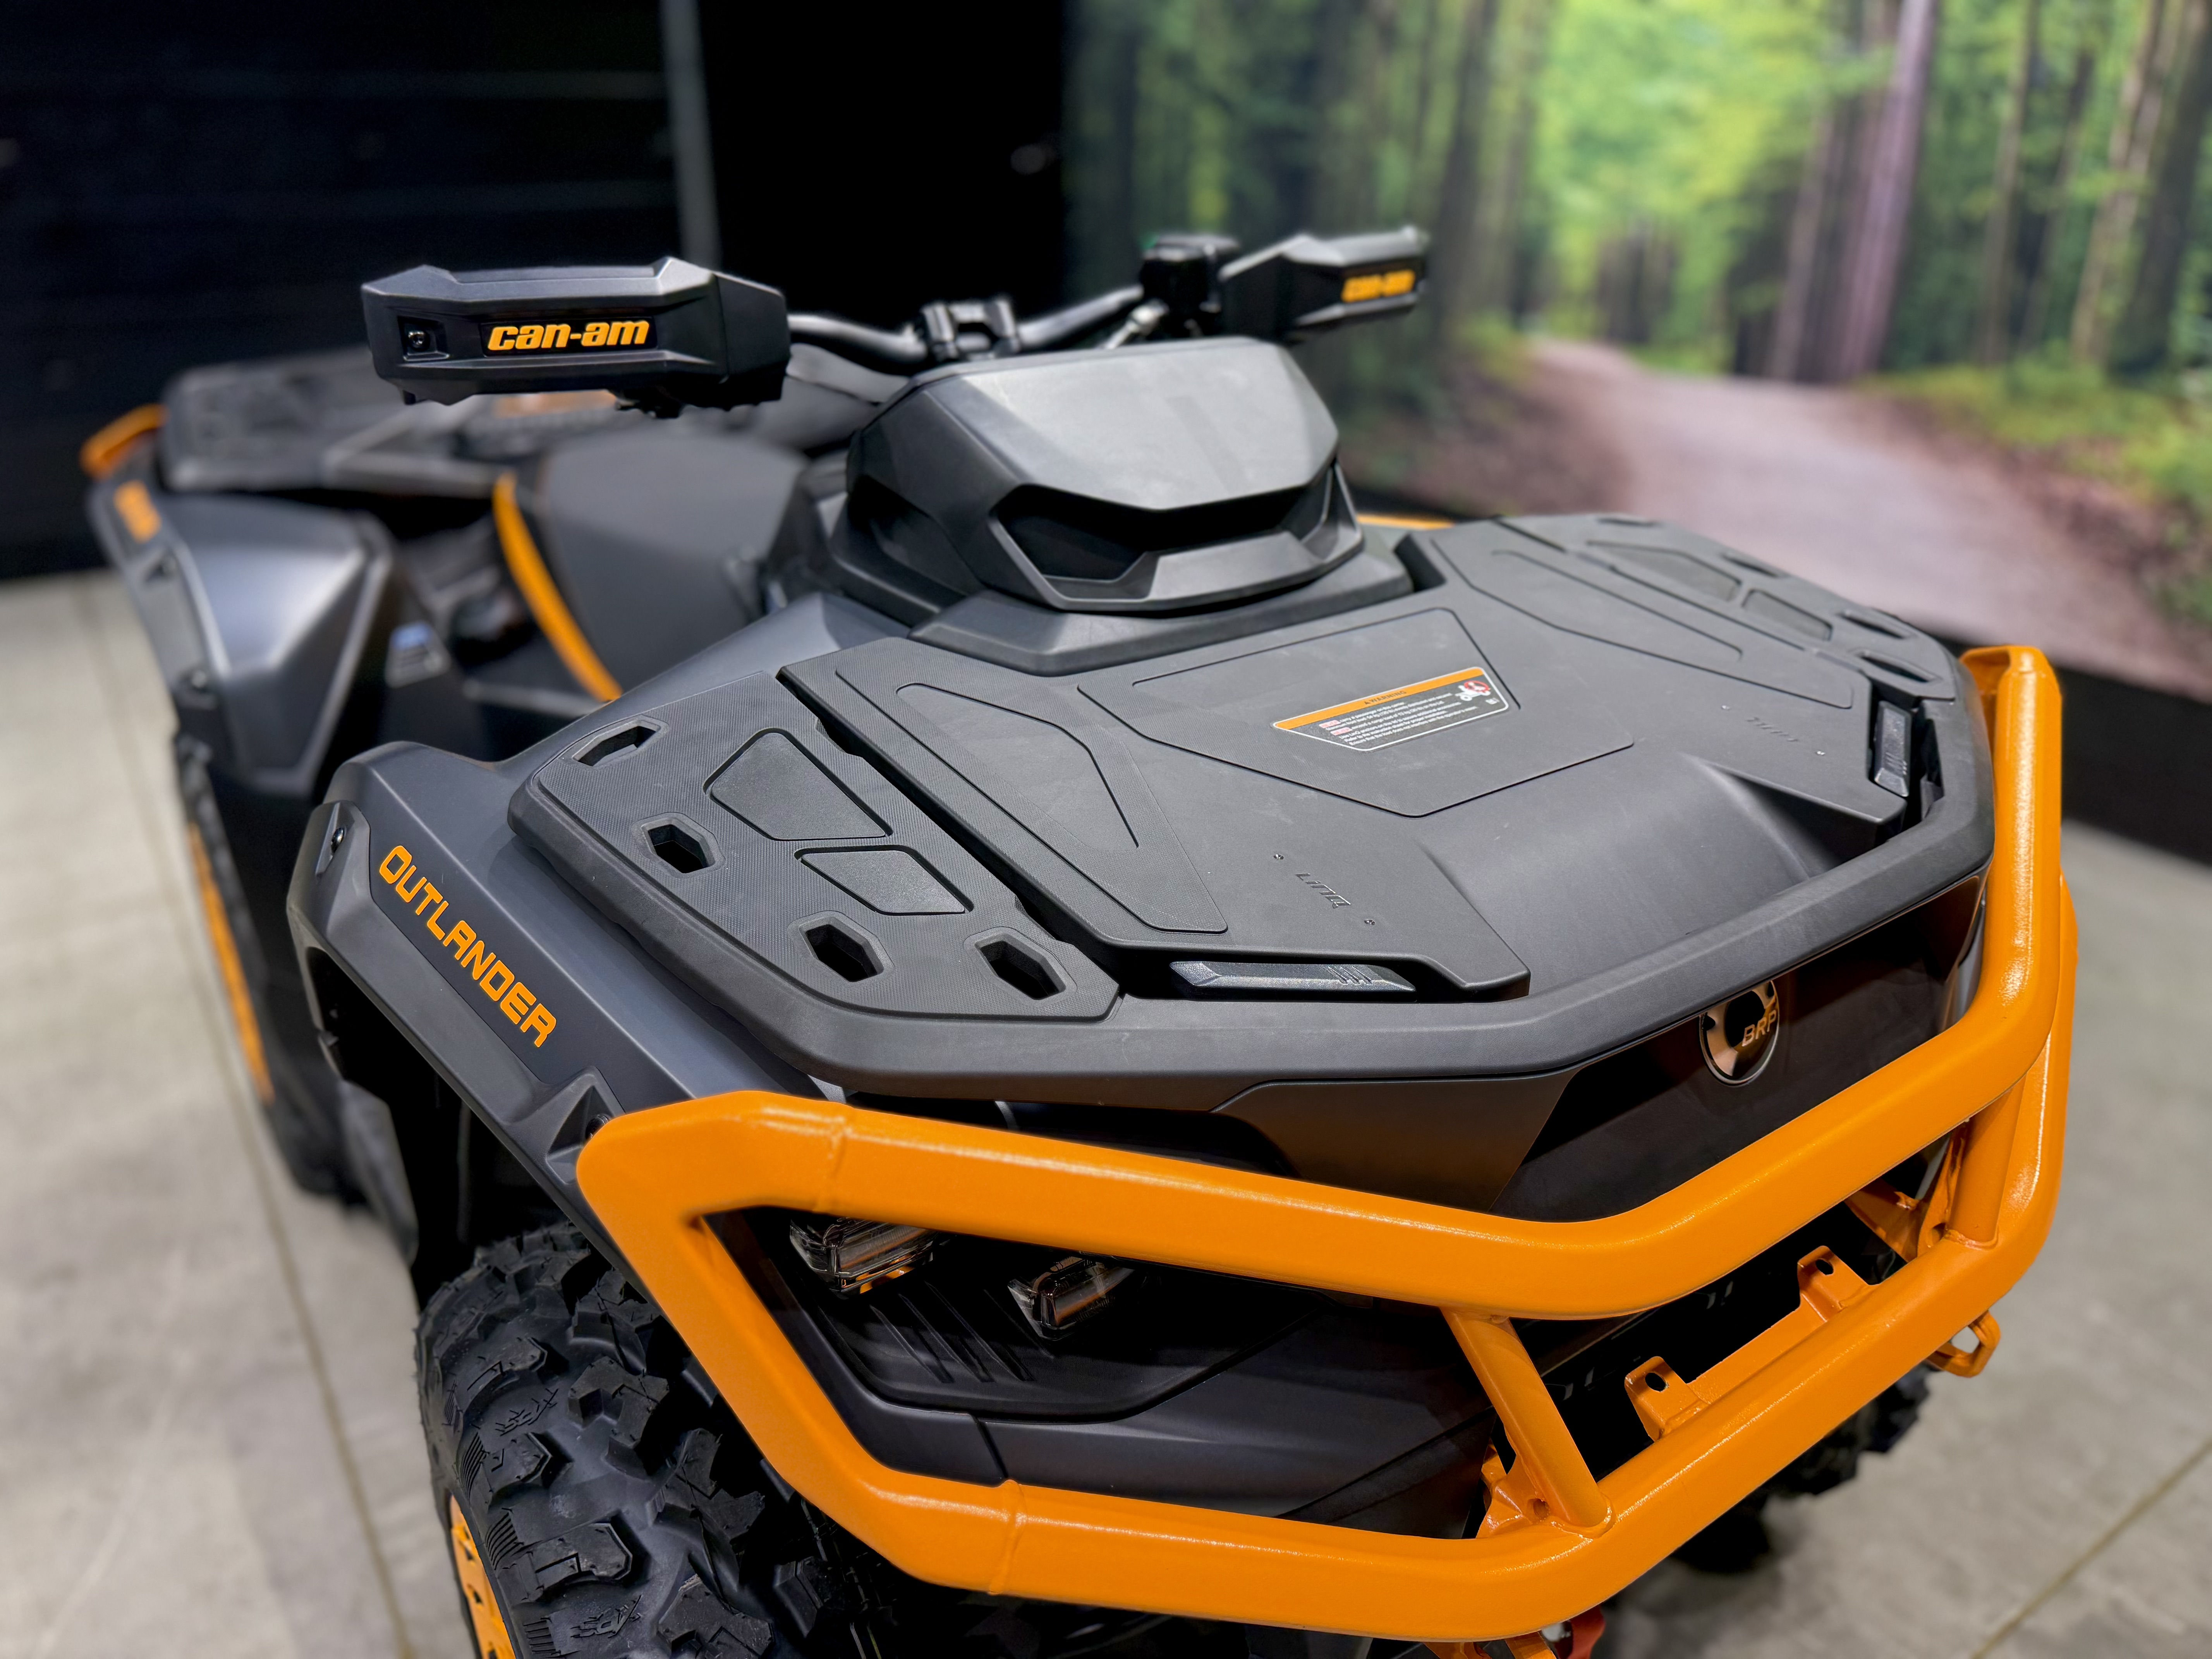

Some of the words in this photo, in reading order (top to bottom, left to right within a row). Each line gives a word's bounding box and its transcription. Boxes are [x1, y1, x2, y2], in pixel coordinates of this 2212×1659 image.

[488, 321, 649, 350] can-am
[380, 845, 556, 1048] OUTLANDER
[1742, 1010, 1776, 1046] BRP
